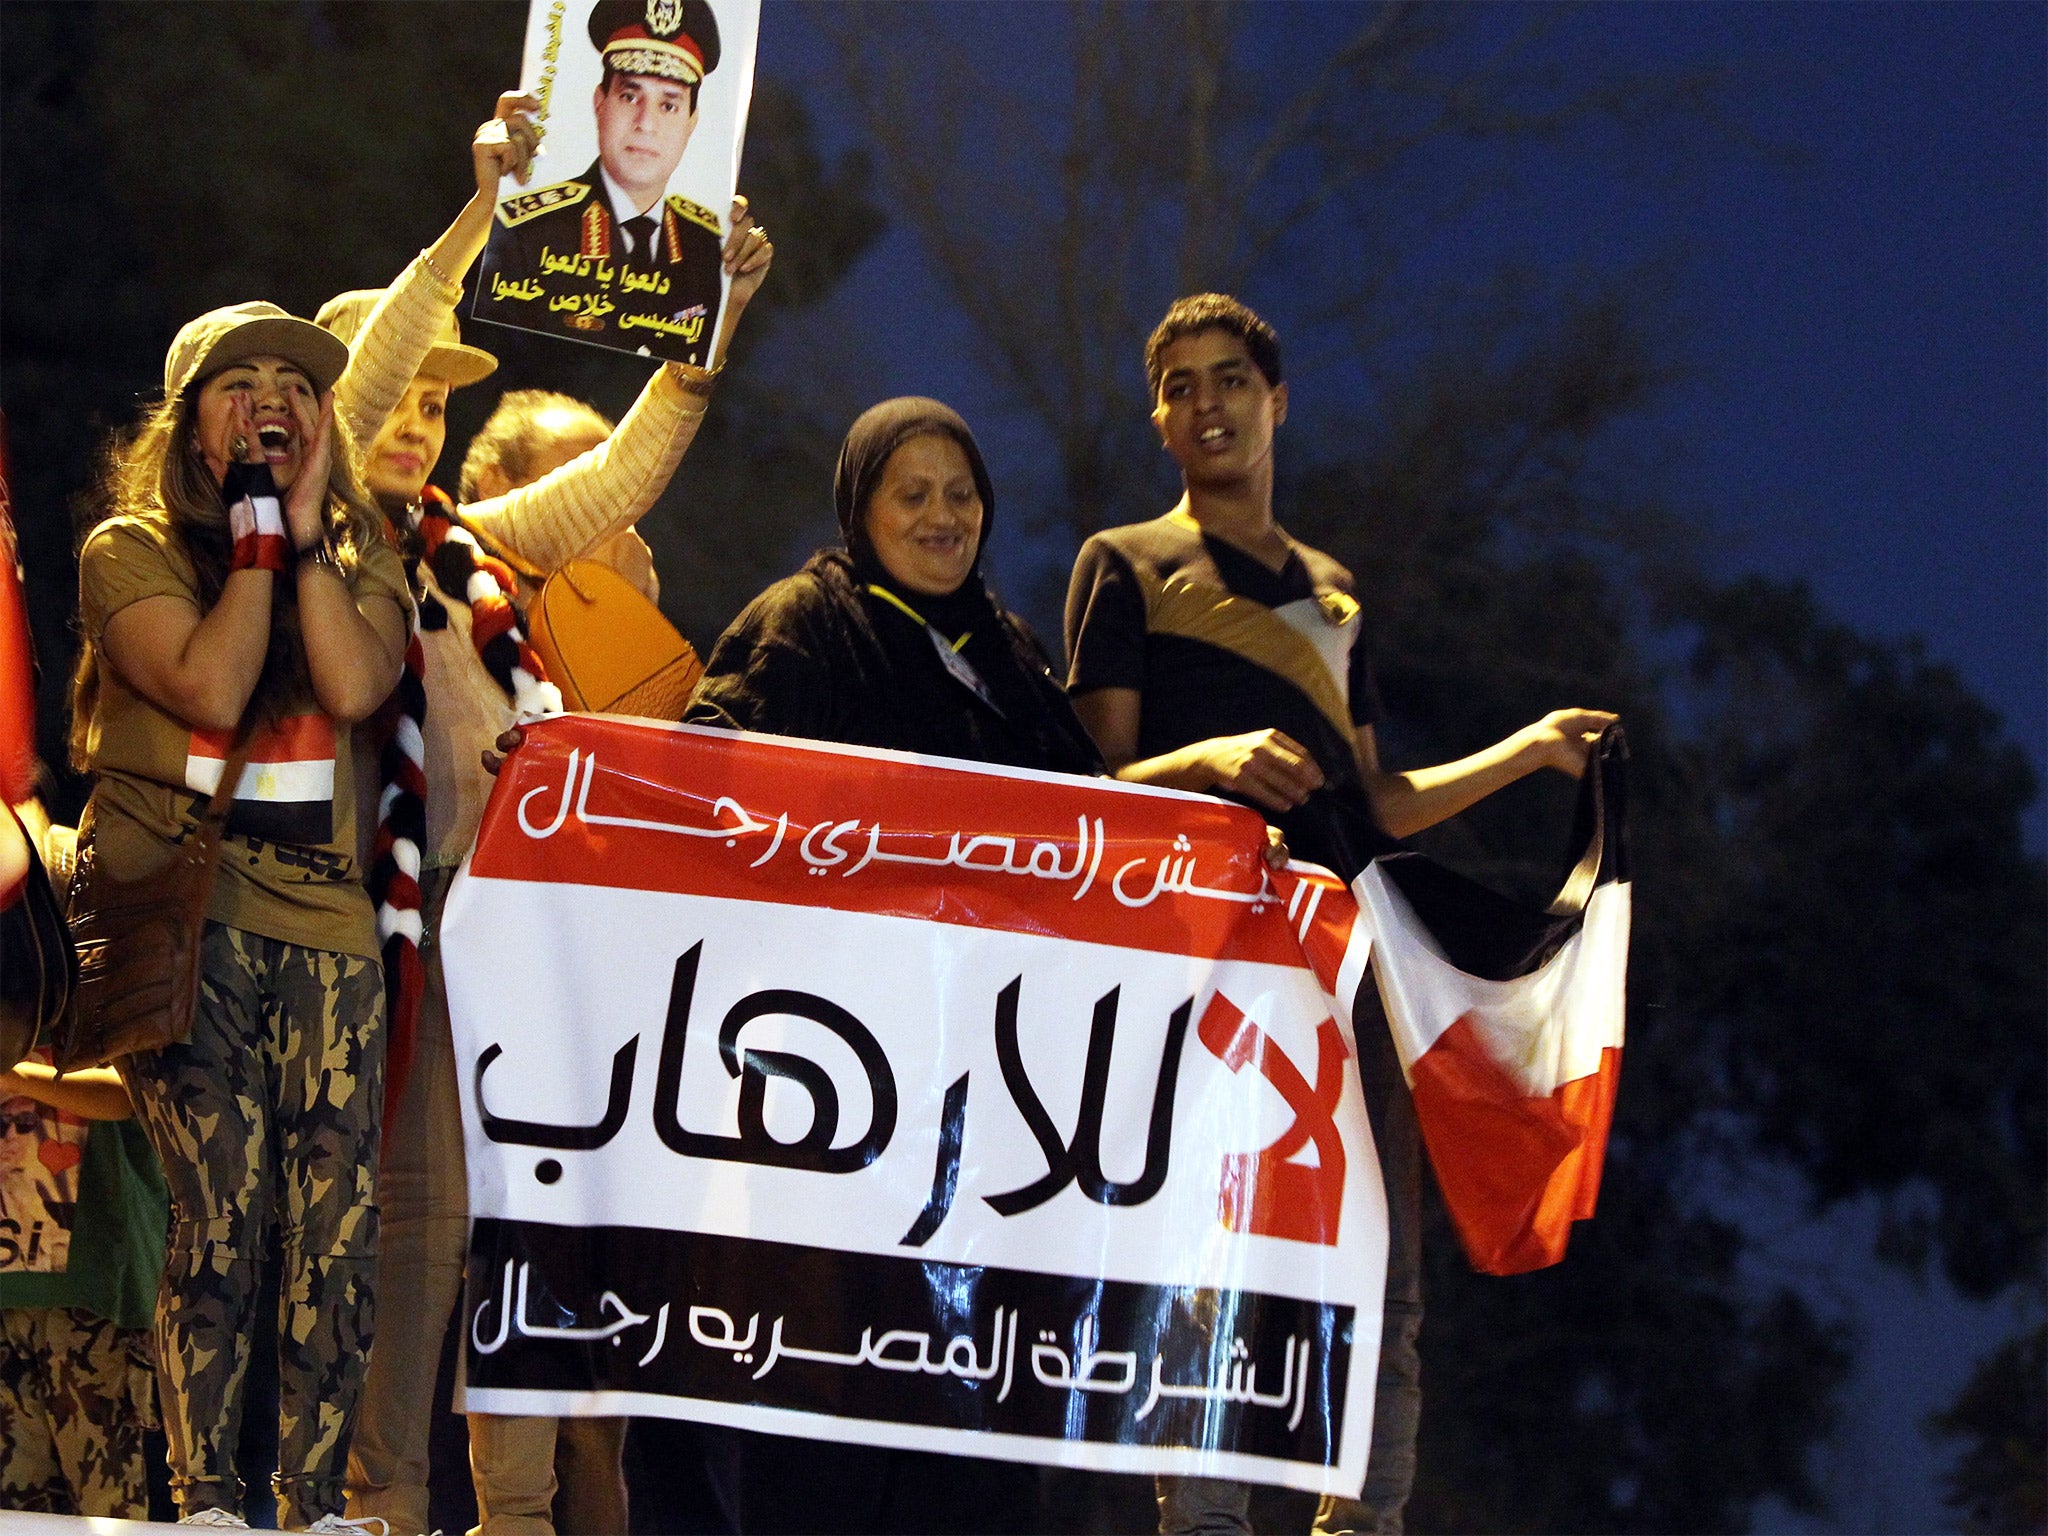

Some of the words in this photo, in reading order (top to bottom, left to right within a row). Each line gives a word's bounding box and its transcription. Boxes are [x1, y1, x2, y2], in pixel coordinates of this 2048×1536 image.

[491, 271, 545, 301] خلعوا
[539, 245, 590, 277] دلعوا
[548, 293, 616, 317] خلاص
[595, 258, 614, 289] يا
[619, 263, 671, 295] دلعوا
[517, 747, 788, 868] رجال
[800, 813, 1104, 901] المصري
[1112, 833, 1325, 944] اليش
[471, 1257, 670, 1368] رجال
[688, 1304, 1018, 1403] المصريه
[1031, 1314, 1310, 1432] الشرطة
